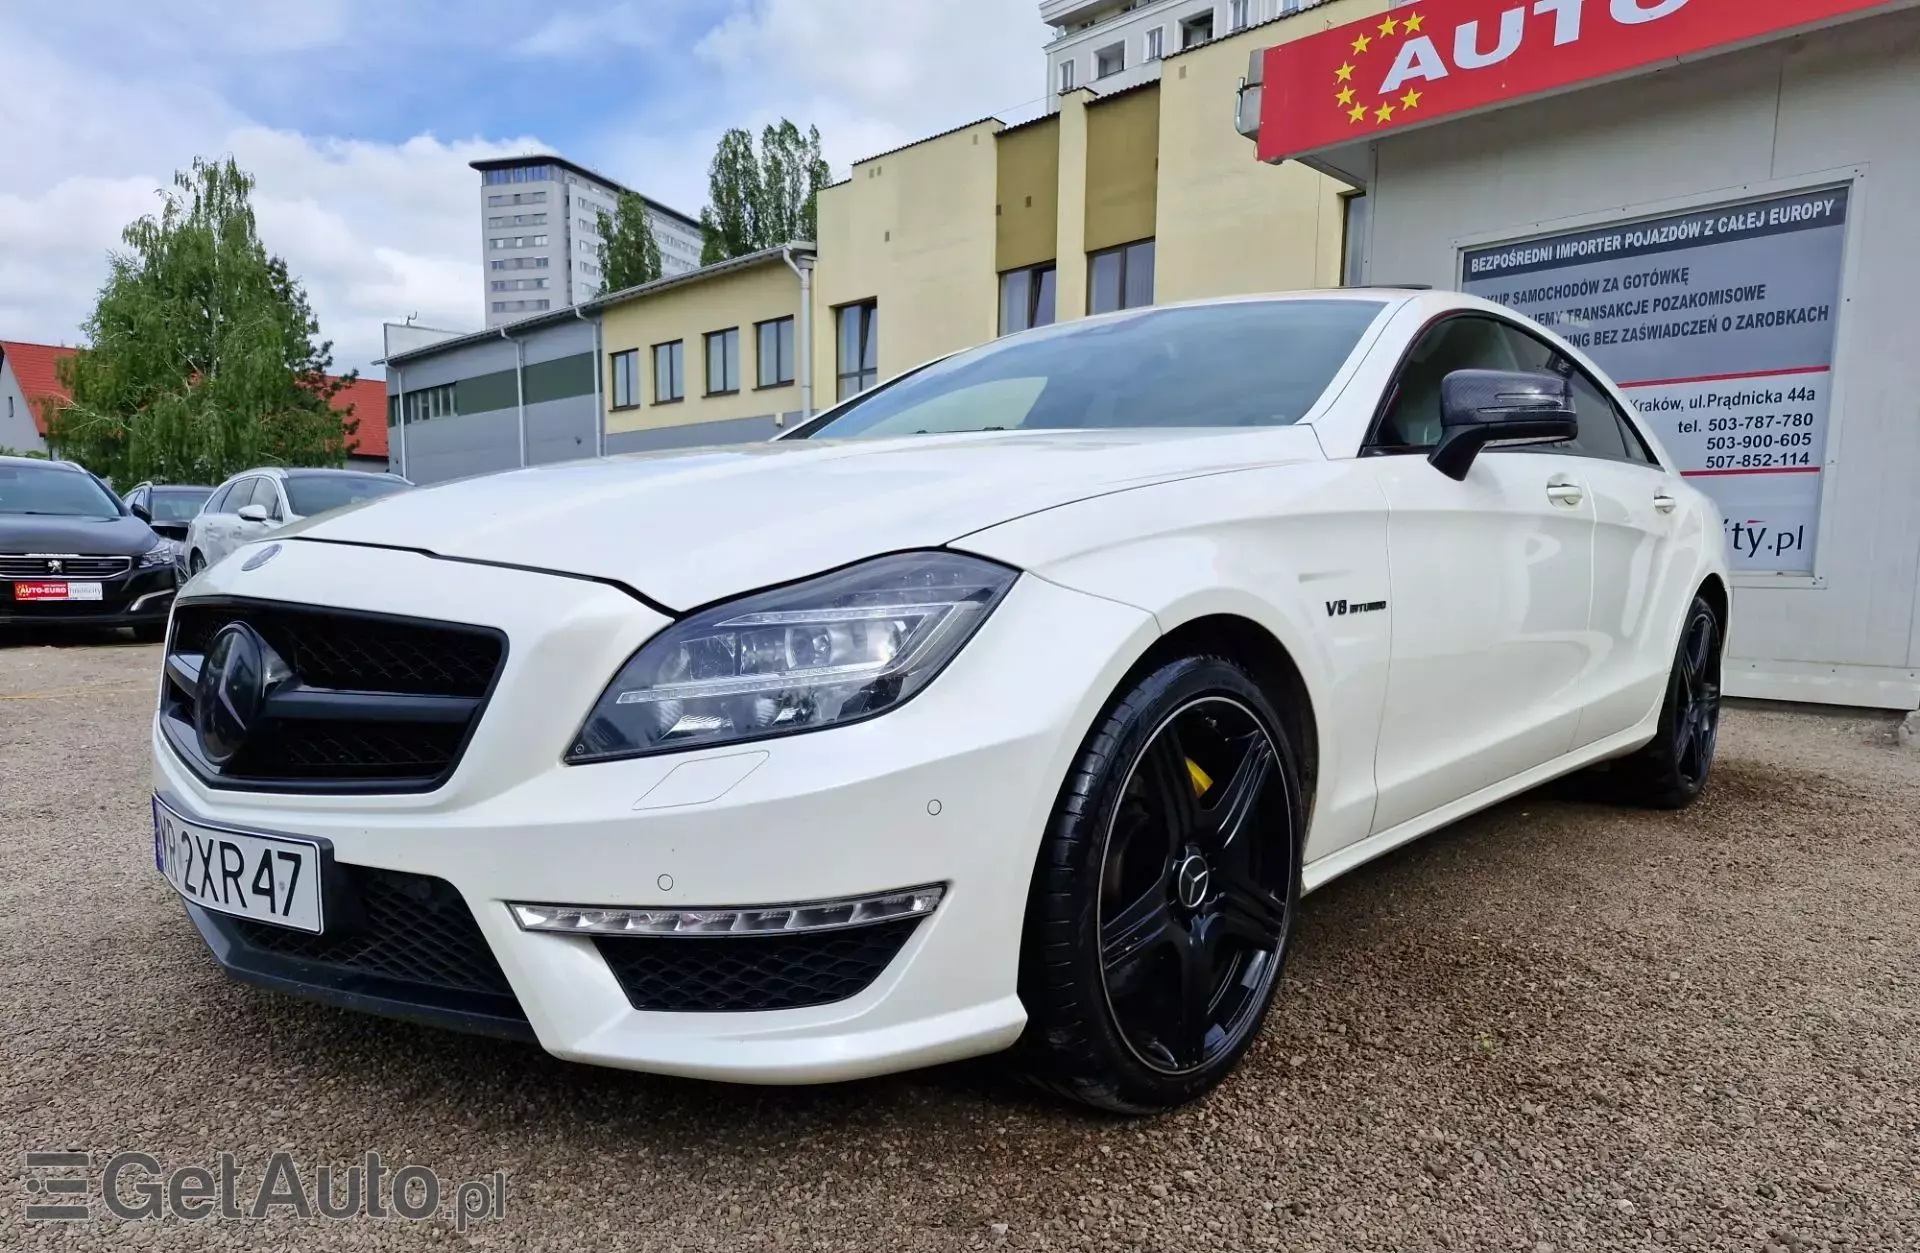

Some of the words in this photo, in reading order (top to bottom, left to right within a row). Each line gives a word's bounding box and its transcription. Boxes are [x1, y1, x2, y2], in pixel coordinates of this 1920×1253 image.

[1471, 246, 1553, 273] BEZPOŚREDNI
[1556, 236, 1621, 260] IMPORTER
[1625, 221, 1700, 249] POJAZDÓW
[1704, 220, 1714, 236] Z
[1717, 210, 1765, 233] CAŁEJ
[1769, 199, 1835, 226] EUROPY
[1513, 280, 1599, 305] SAMOCHODÓW
[1602, 276, 1620, 292] ZA
[1623, 267, 1690, 288] GOTÓWKĘ
[1567, 302, 1649, 322] TRANSAKCJE
[1653, 284, 1766, 313] POZAKOMISOWE
[1594, 328, 1618, 346] BEZ
[1621, 317, 1718, 342] ZAŚWIADCZEŃ
[1721, 316, 1732, 332] O
[1736, 305, 1829, 331] ZAROBKACH
[1630, 398, 1684, 414] Kraków,
[1689, 390, 1783, 410] ul.Prądnicka
[1787, 387, 1815, 402] 44a
[1678, 419, 1702, 433] tel.
[1708, 412, 1813, 432] 503-787-780
[1706, 433, 1812, 450] 503-900-605
[1705, 452, 1810, 469] 507-852-114
[1722, 516, 1804, 557] ty.pl
[1325, 600, 1347, 617] V8
